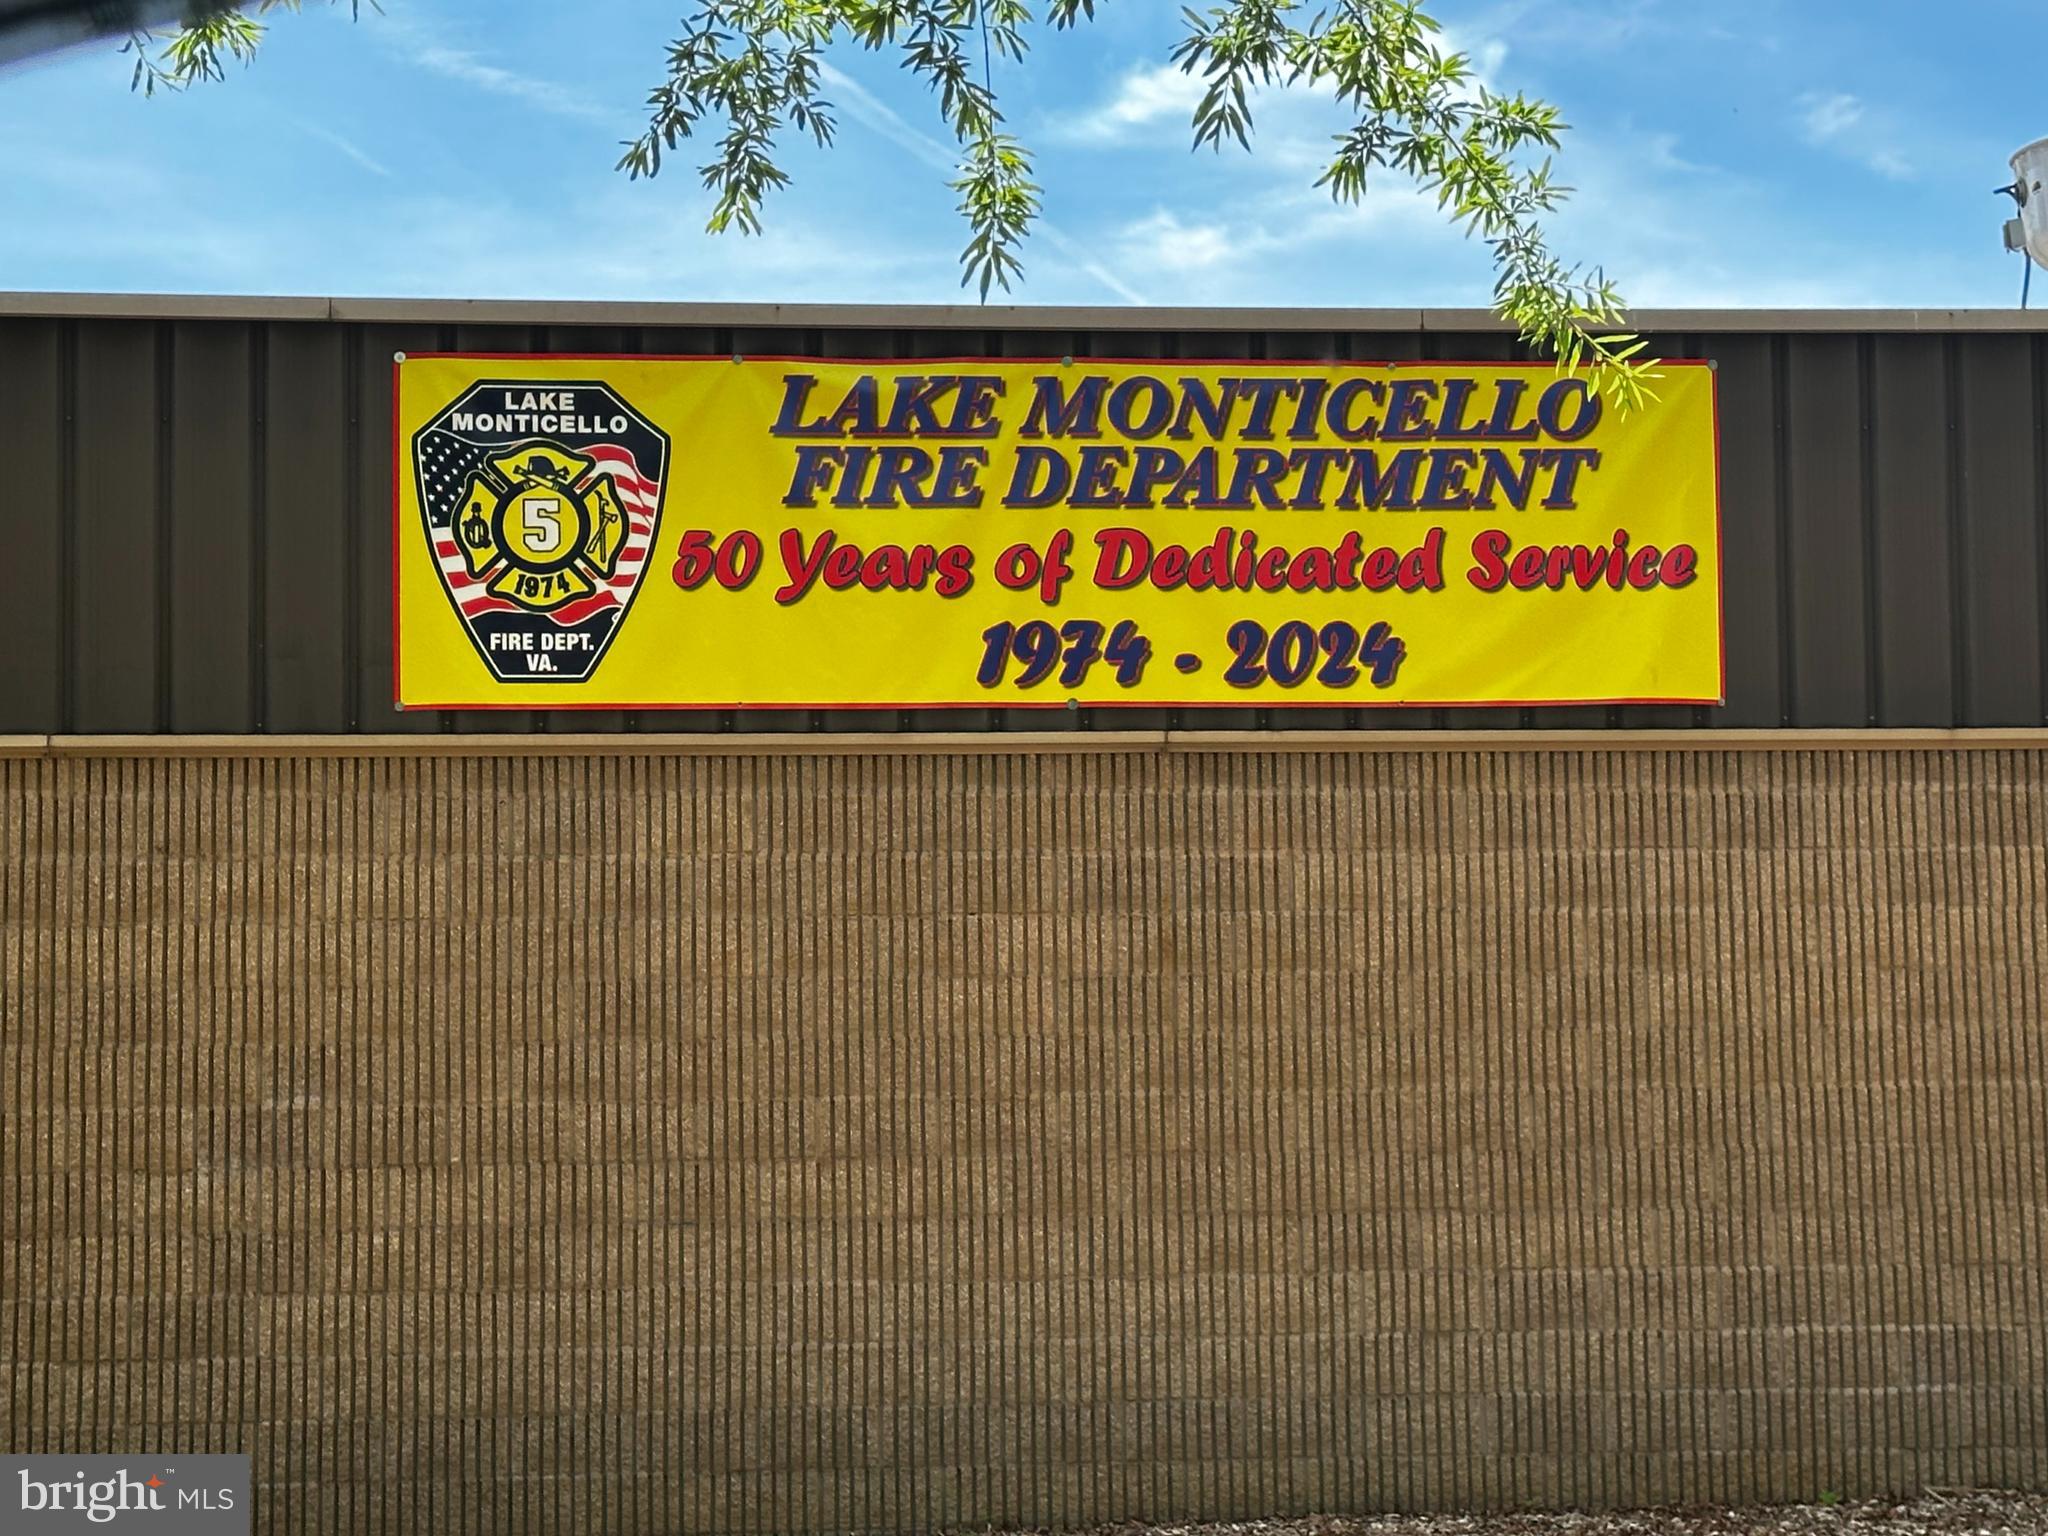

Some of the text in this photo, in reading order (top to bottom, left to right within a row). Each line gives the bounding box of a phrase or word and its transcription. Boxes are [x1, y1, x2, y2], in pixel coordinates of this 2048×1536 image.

[505, 392, 574, 411] LAKE
[768, 374, 1603, 442] LAKE MONTICELLO
[452, 413, 628, 434] MONTICELLO
[782, 446, 1600, 511] FIRE DEPARTMENT
[522, 498, 561, 552] 5
[672, 526, 1698, 605] 50 Years of Dedicated Service
[514, 573, 570, 598] 1974
[490, 633, 594, 650] FIRE DEPT.
[976, 619, 1151, 689] 1974
[1223, 619, 1405, 689] 2024
[526, 654, 557, 671] VA.
